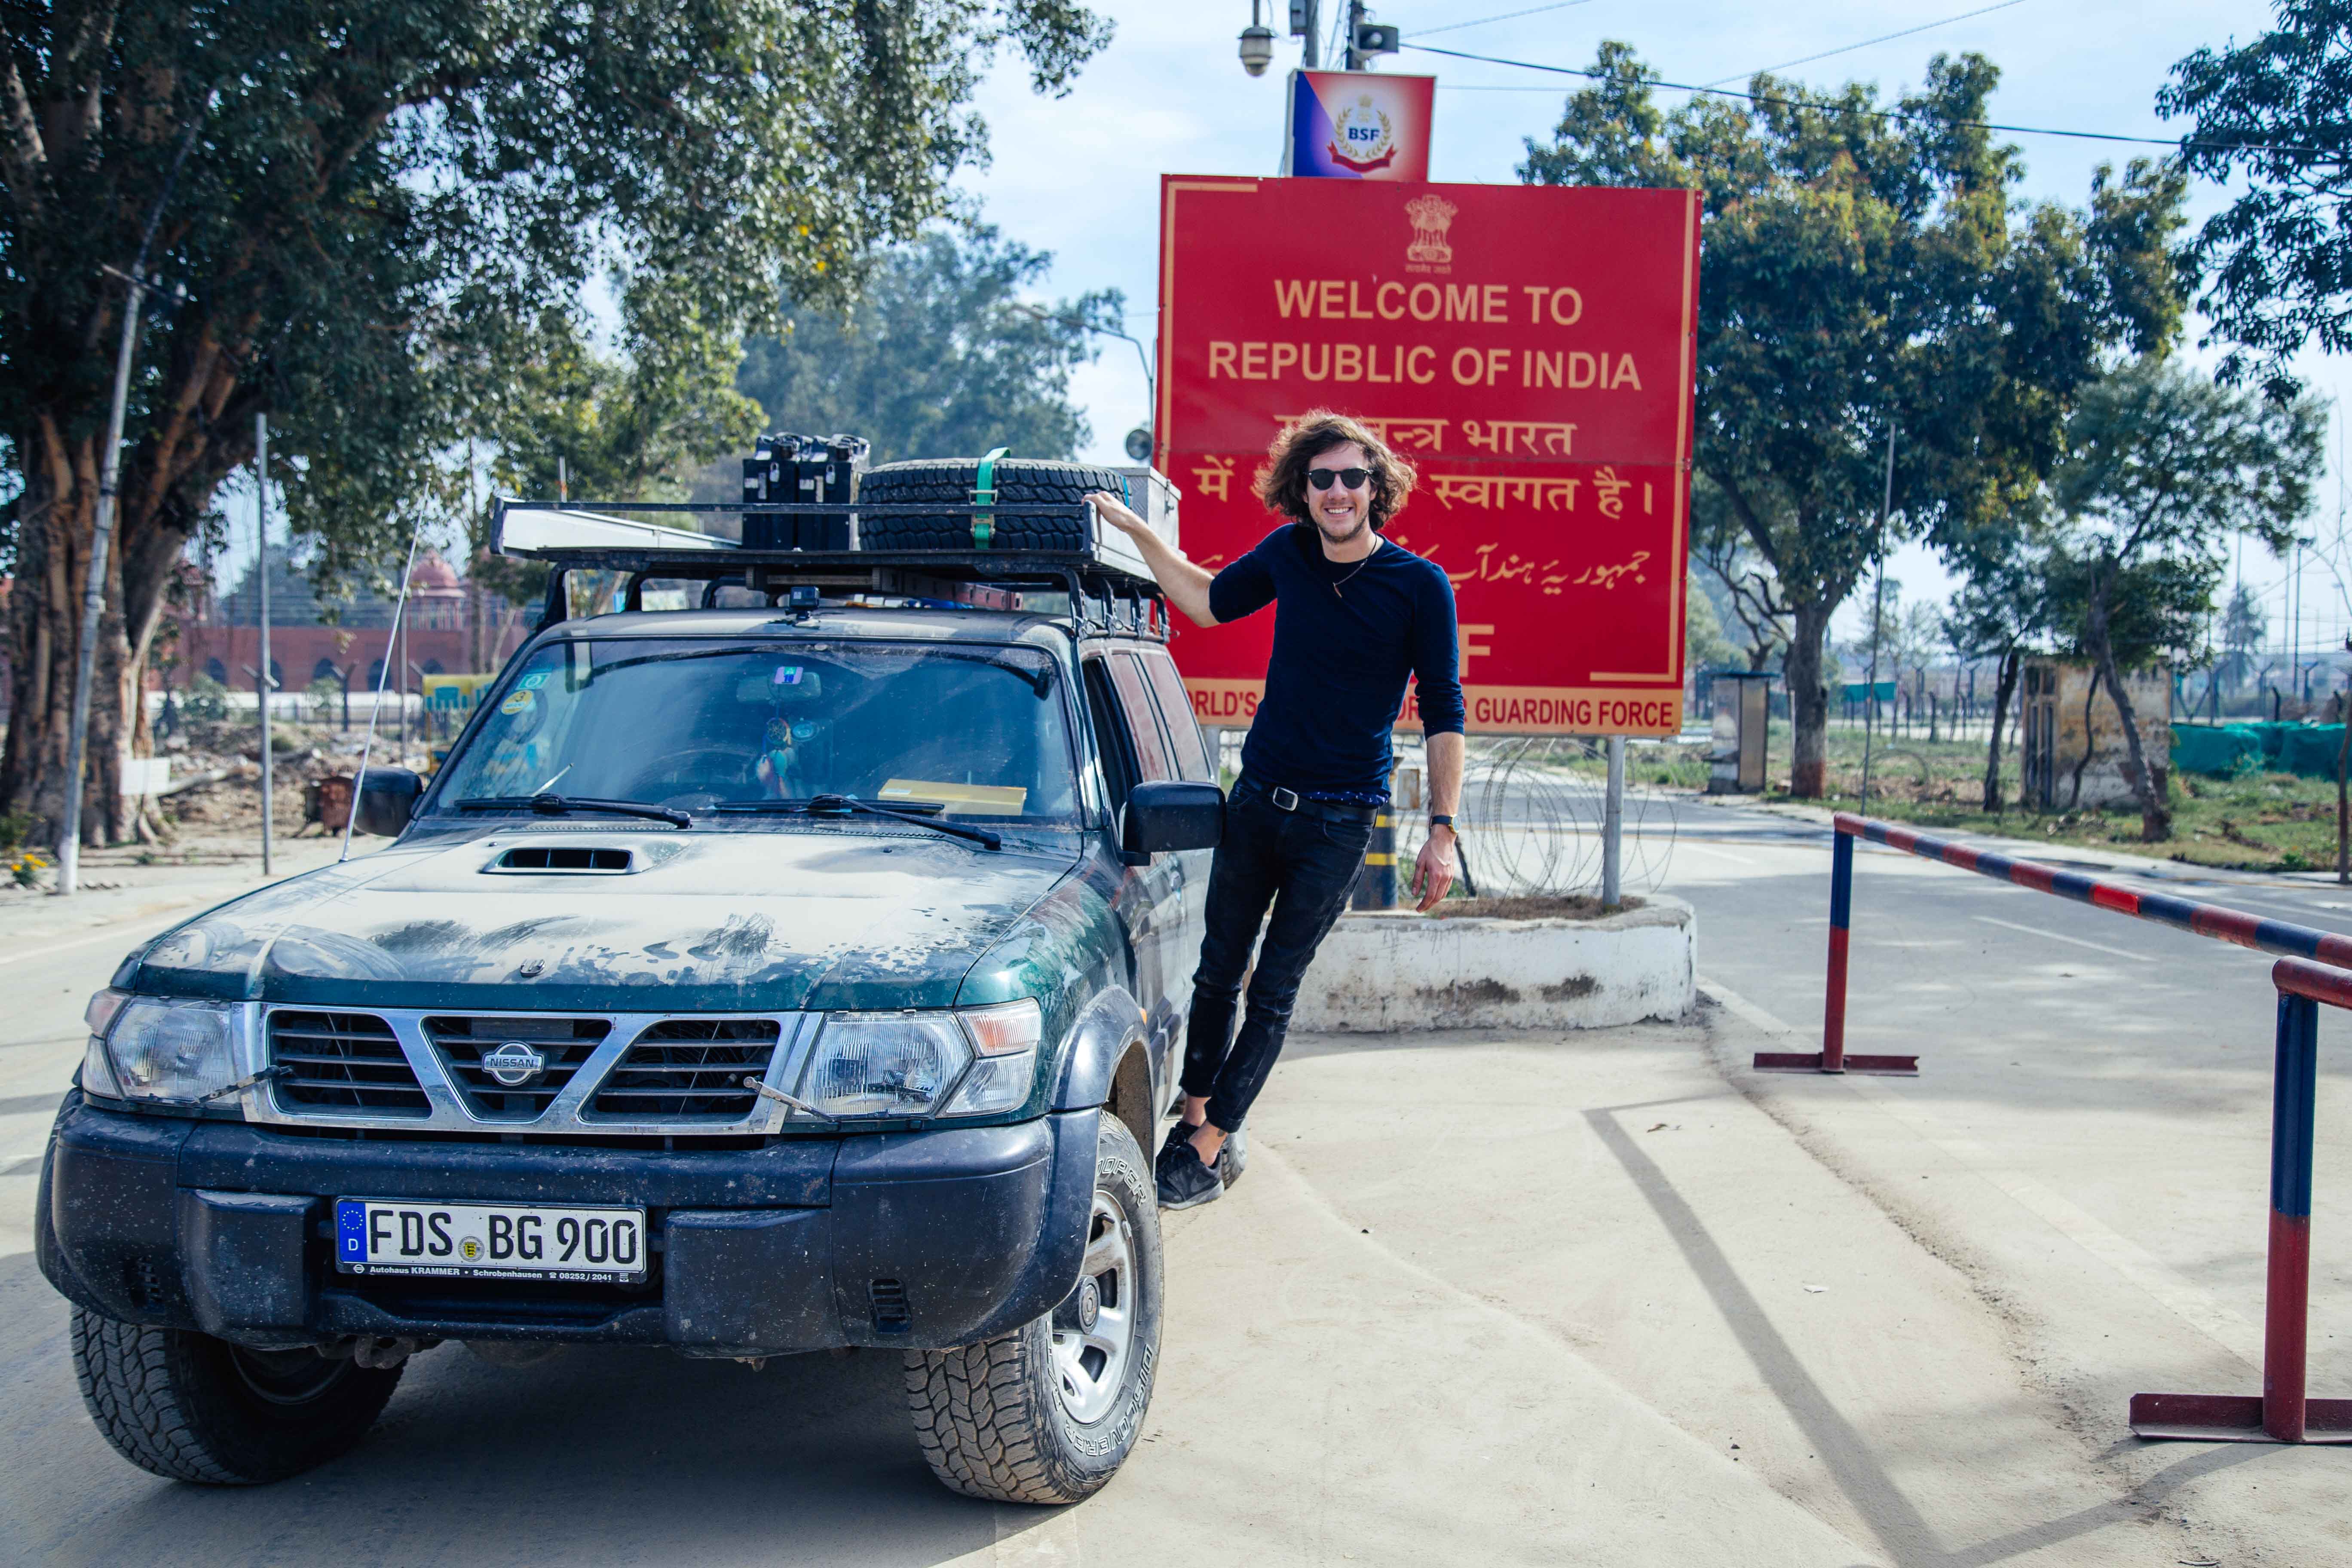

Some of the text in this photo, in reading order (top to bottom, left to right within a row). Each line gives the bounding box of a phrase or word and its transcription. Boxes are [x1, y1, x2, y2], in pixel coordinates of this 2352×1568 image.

[1348, 127, 1380, 141] BSF
[1274, 279, 1583, 326] WELCOME TO
[1209, 341, 1642, 391] REPUBLIC OF INDIA
[1462, 420, 1578, 456] भारत
[1191, 454, 1235, 502] में
[1429, 475, 1580, 512] स्वागत
[1187, 689, 1258, 718] RLD'S
[1475, 697, 1592, 726] GUARDING
[1599, 700, 1674, 728] FORCE
[490, 1058, 534, 1067] NISSAN
[348, 1238, 358, 1251] D
[369, 1210, 453, 1256] FDS
[489, 1214, 542, 1260] BG
[558, 1217, 637, 1264] 900
[411, 1267, 460, 1275] KRAMMER
[473, 1269, 542, 1279] Schrobenhausen
[1064, 1344, 1152, 1456] DISCOVERER
